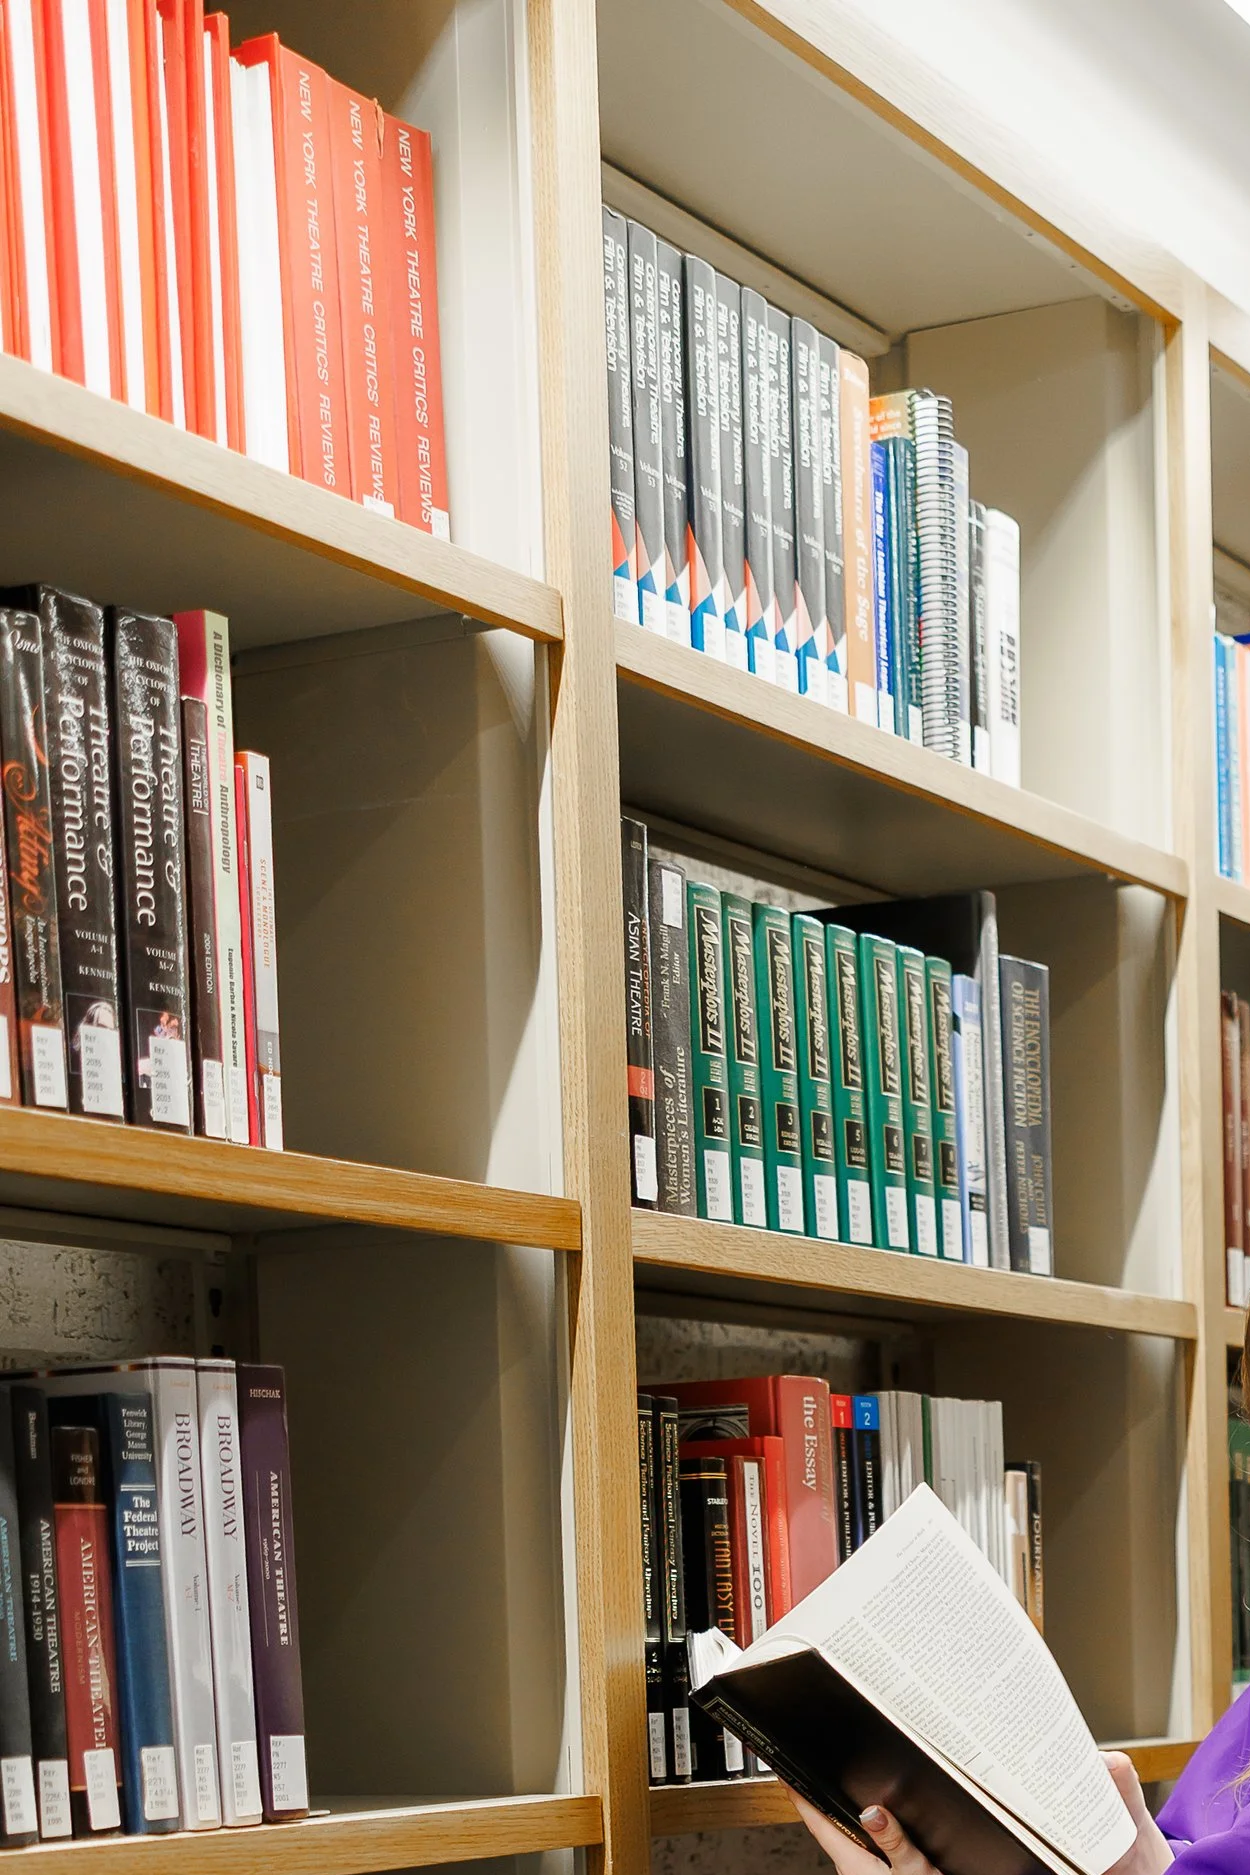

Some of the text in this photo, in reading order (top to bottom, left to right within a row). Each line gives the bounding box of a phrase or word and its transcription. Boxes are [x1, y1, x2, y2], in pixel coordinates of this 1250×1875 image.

[299, 71, 336, 487] NEW YORK THEATRE CRITICS' REVIEWS
[349, 100, 385, 502] NEW YORK THEATRE CRITICS' REVIEWS
[604, 234, 615, 272] Film
[616, 244, 630, 363] Contemporary
[659, 270, 670, 306] Film
[398, 128, 434, 524] NEW YORK THEATRE CRITICS' REVIEWS
[605, 297, 617, 372] Television
[661, 330, 673, 403] Television
[213, 644, 226, 713] Dictionary
[217, 714, 226, 729] of
[58, 694, 89, 911] Performance
[89, 705, 110, 830] Theatre
[129, 714, 158, 927] Performance
[160, 726, 180, 847] Theatre
[190, 744, 203, 812] THEATRE
[219, 784, 231, 874] Anthropology
[205, 956, 213, 995] EDITION
[628, 911, 643, 1037] ASIAN THEATRE
[660, 925, 669, 954] Magill
[661, 974, 670, 1009] Frank
[672, 951, 681, 985] Editor
[700, 911, 723, 1052] Masterplots II
[734, 922, 756, 1062] Masterplots II
[772, 932, 795, 1069] Masterplots II
[808, 943, 829, 1077] Masterplots II
[840, 953, 862, 1085] Masterplots II
[714, 1098, 721, 1111] 1
[1011, 981, 1028, 1128] OF SCIENCE FICTION
[1024, 988, 1043, 1127] THE ENCYCLOPEDIA
[659, 1065, 677, 1203] Masterpieces of
[677, 1046, 690, 1205] Women's Literature
[748, 1106, 755, 1119] 2
[787, 1113, 794, 1125] 3
[802, 1395, 818, 1492] the Essay
[864, 1412, 871, 1426] 2
[124, 1510, 158, 1523] Federal
[132, 1496, 150, 1509] The
[175, 1412, 197, 1540] BROADWAY
[217, 1415, 238, 1542] BROADWAY
[865, 1461, 874, 1500] EDITOR
[124, 1524, 159, 1537] Theatre
[127, 1539, 159, 1553] Project
[270, 1471, 289, 1647] AMERICAN THEATRE
[750, 1504, 763, 1610] NOVEL 100
[30, 1573, 42, 1641] 1914-1930
[40, 1519, 61, 1694] AMERICAN THEATRE
[81, 1537, 99, 1648] AMERICAN
